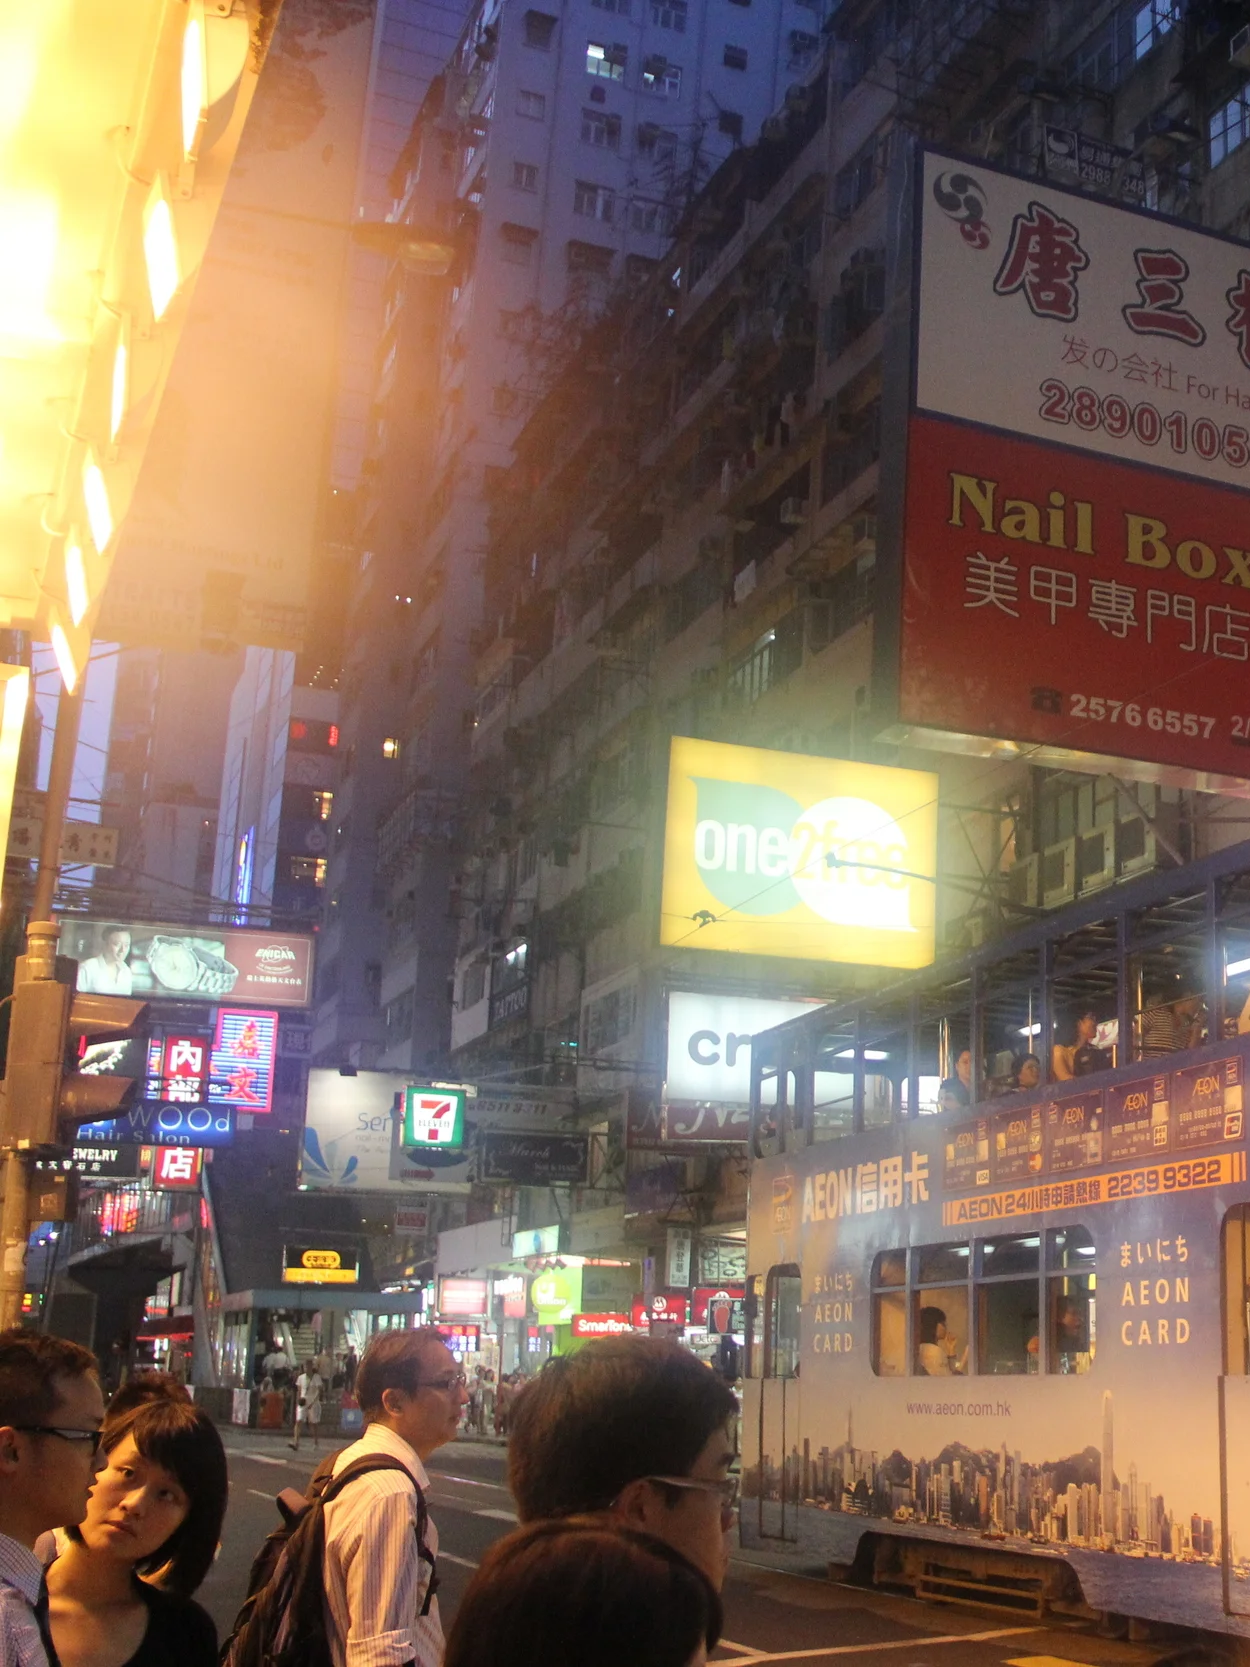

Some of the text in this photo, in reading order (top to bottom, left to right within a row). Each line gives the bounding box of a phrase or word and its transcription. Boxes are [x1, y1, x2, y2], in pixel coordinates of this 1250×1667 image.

[1186, 375, 1219, 400] For
[948, 472, 1095, 556] Nail
[963, 551, 1250, 661] 美甲專門店
[1070, 693, 1142, 727] 2576
[1147, 706, 1216, 739] 6557
[76, 1128, 124, 1141] Hair
[1107, 1169, 1160, 1199] 2239
[1163, 1159, 1222, 1190] 9322
[1120, 1235, 1189, 1268] まいにち
[814, 1273, 853, 1294] まいにち
[1122, 1277, 1190, 1306] AEON
[814, 1302, 853, 1323] AEON
[813, 1333, 853, 1353] CARD
[1121, 1318, 1190, 1346] CARD
[906, 1401, 1012, 1417] www.aeon.com.hk
